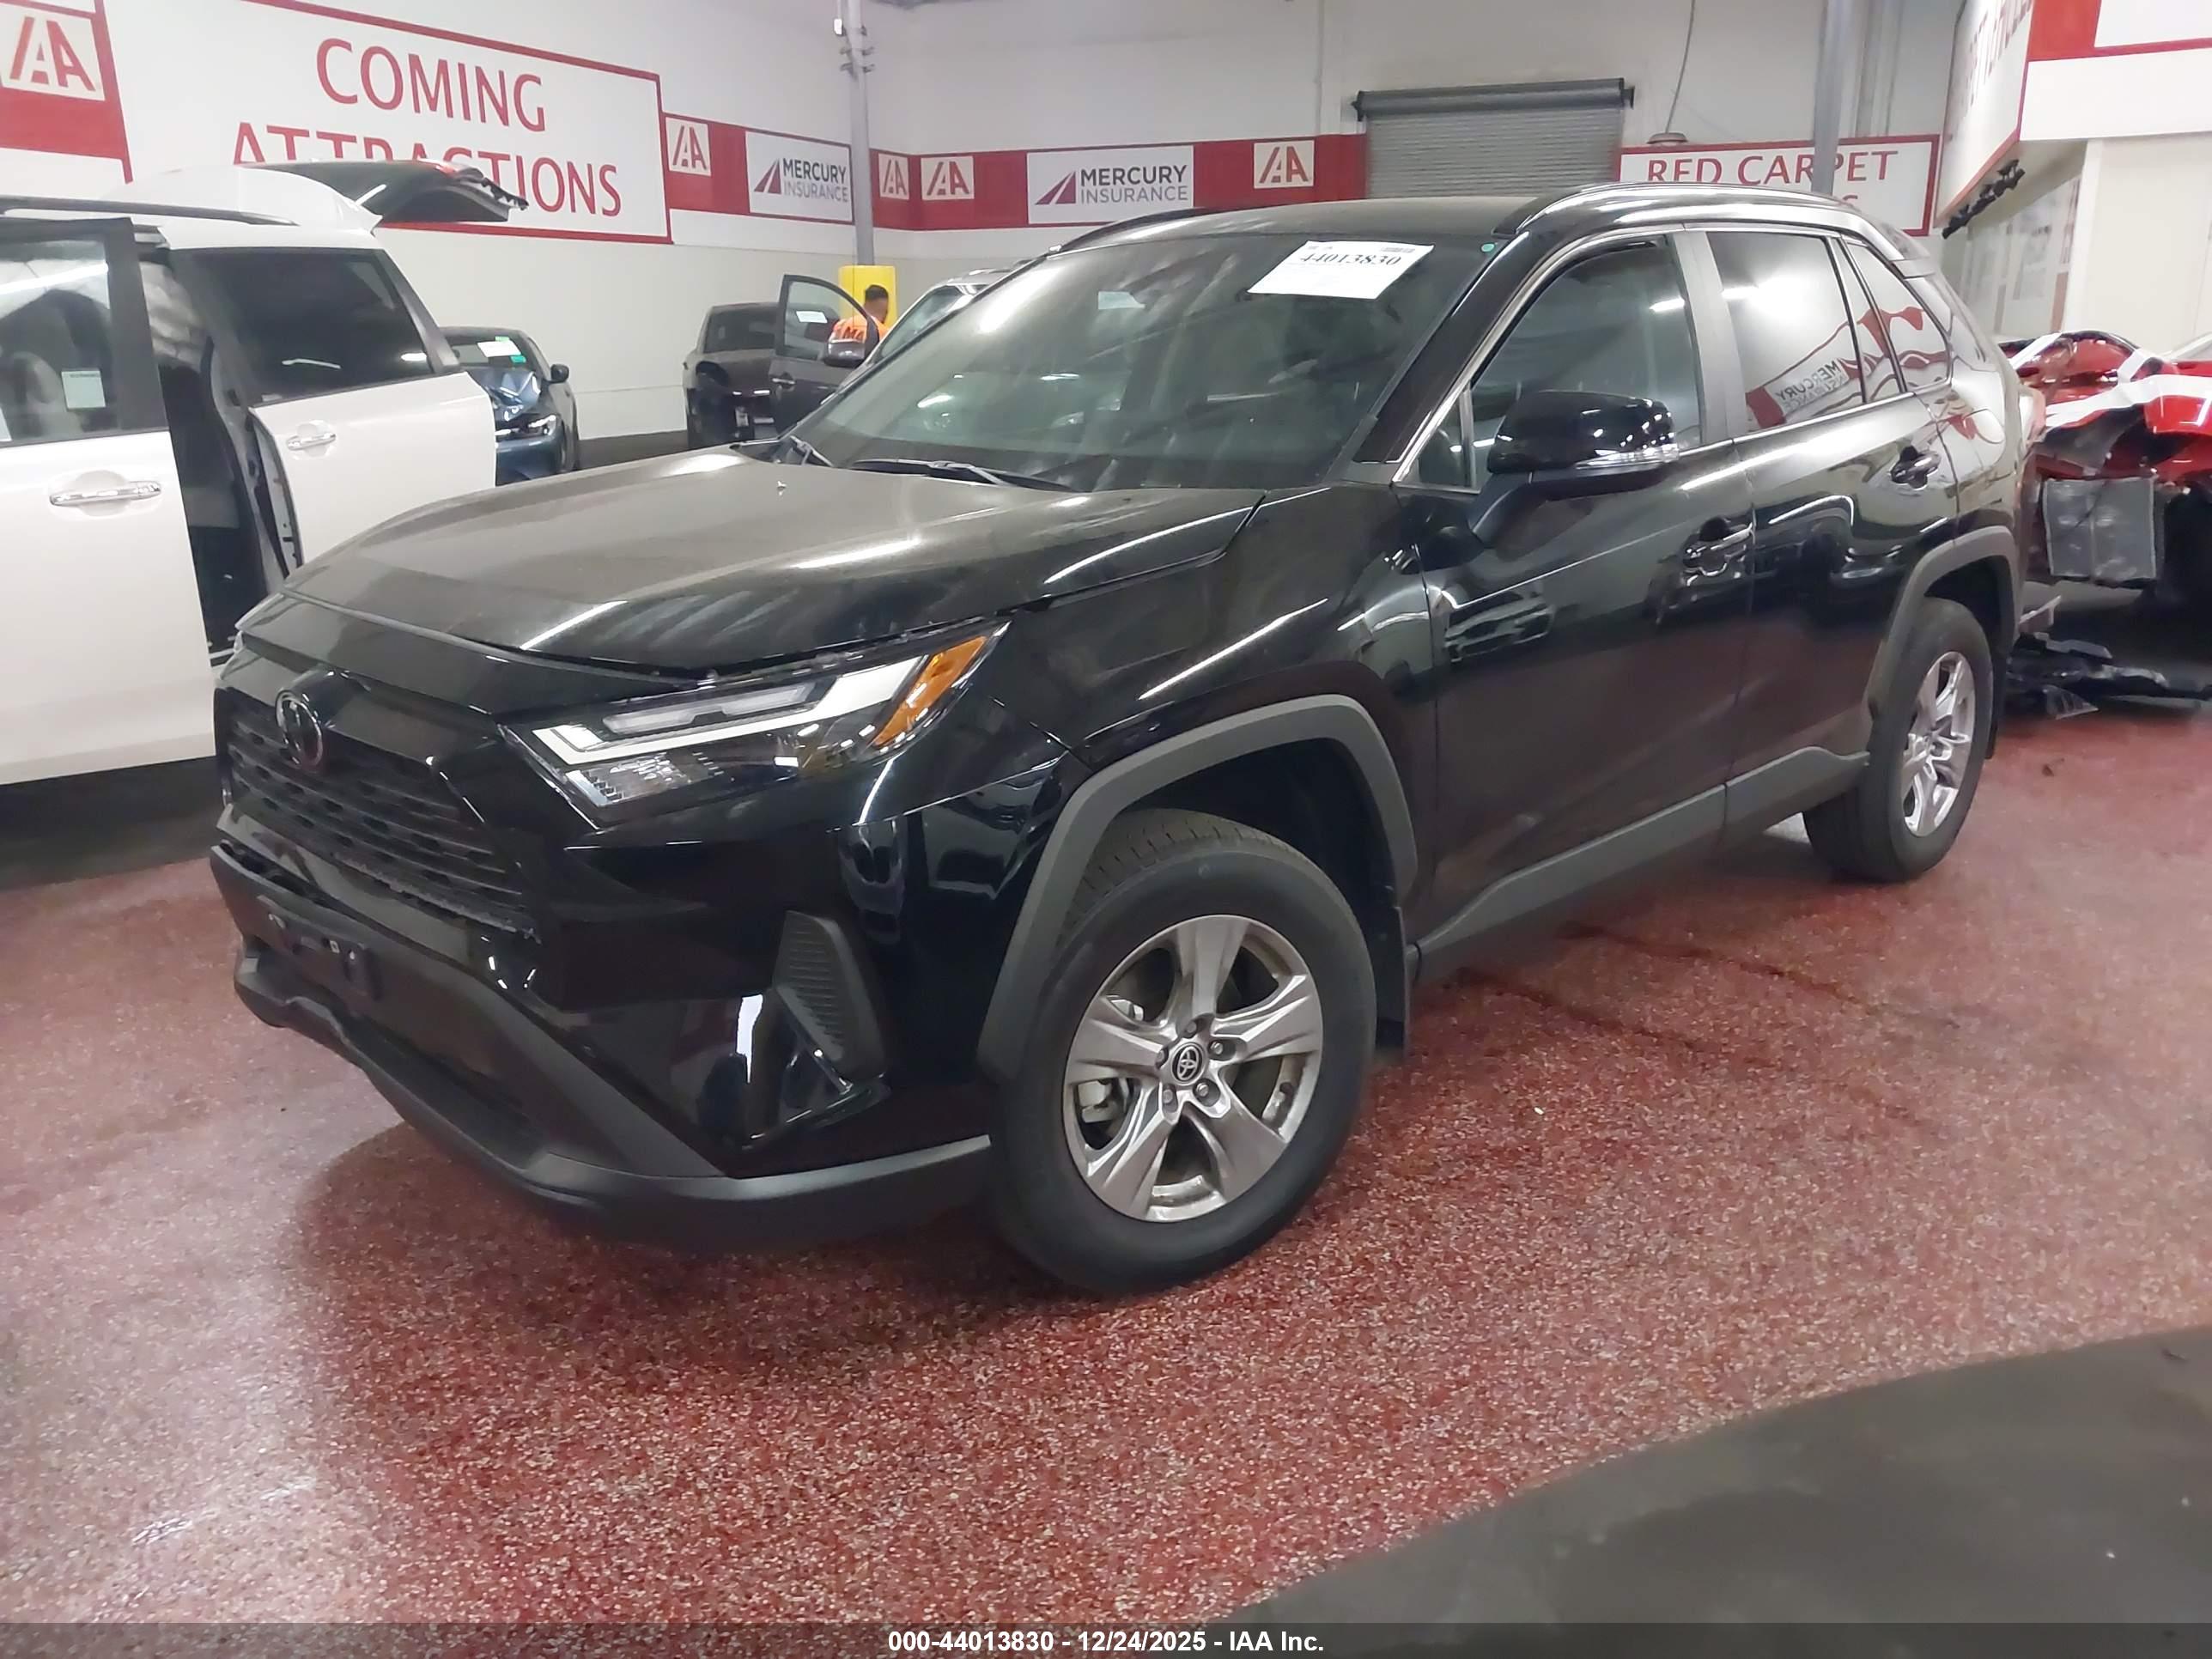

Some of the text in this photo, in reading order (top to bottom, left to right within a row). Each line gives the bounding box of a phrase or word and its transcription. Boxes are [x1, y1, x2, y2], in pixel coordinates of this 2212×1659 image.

[317, 38, 545, 132] COMING
[782, 157, 847, 185] MERCURY
[1080, 164, 1188, 186] MERCURY
[1647, 157, 1723, 183] RED
[784, 179, 848, 204] INSURANCE
[1081, 185, 1188, 204] INSURANCE
[1299, 252, 1403, 266] 44013830
